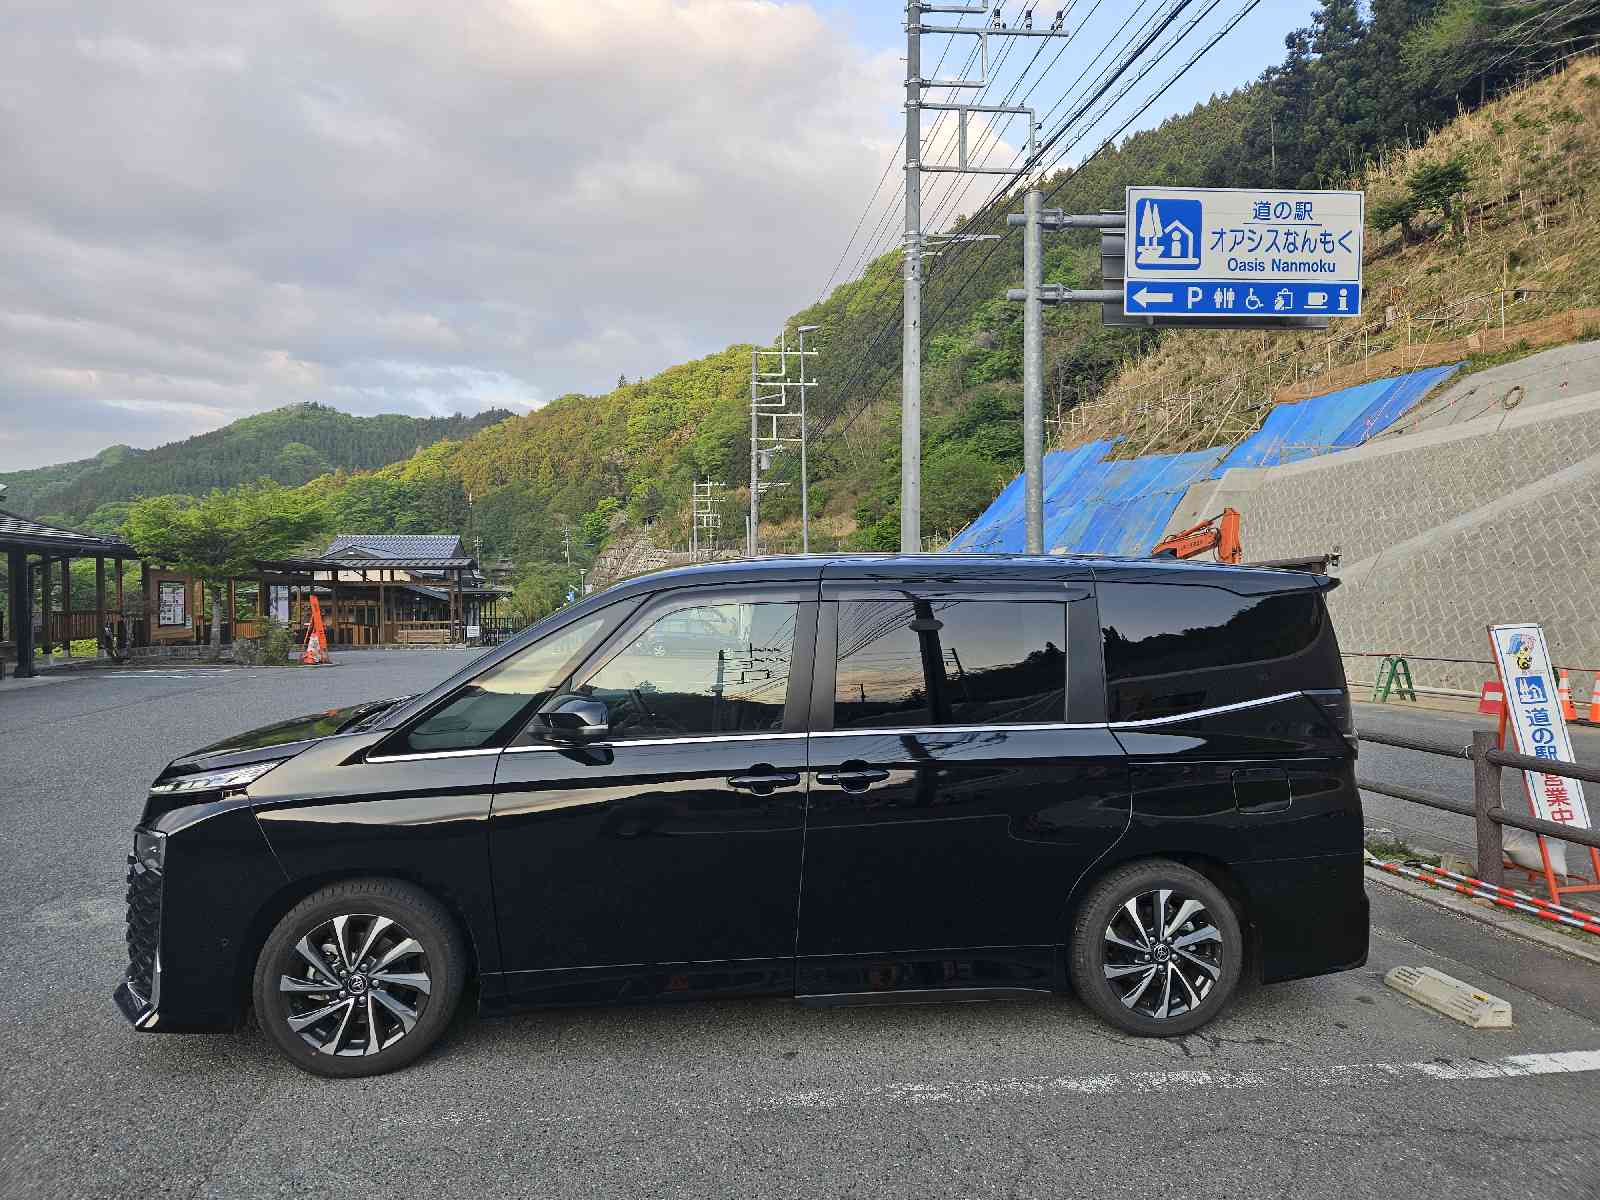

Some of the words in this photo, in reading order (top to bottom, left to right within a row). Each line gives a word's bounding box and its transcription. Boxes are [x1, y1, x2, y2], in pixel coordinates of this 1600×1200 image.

[1253, 201, 1313, 221] 道の駅
[1210, 228, 1353, 253] オアシスなんもく
[1227, 257, 1265, 272] Oasis
[1271, 258, 1336, 273] Nanmoku
[1187, 287, 1202, 309] P
